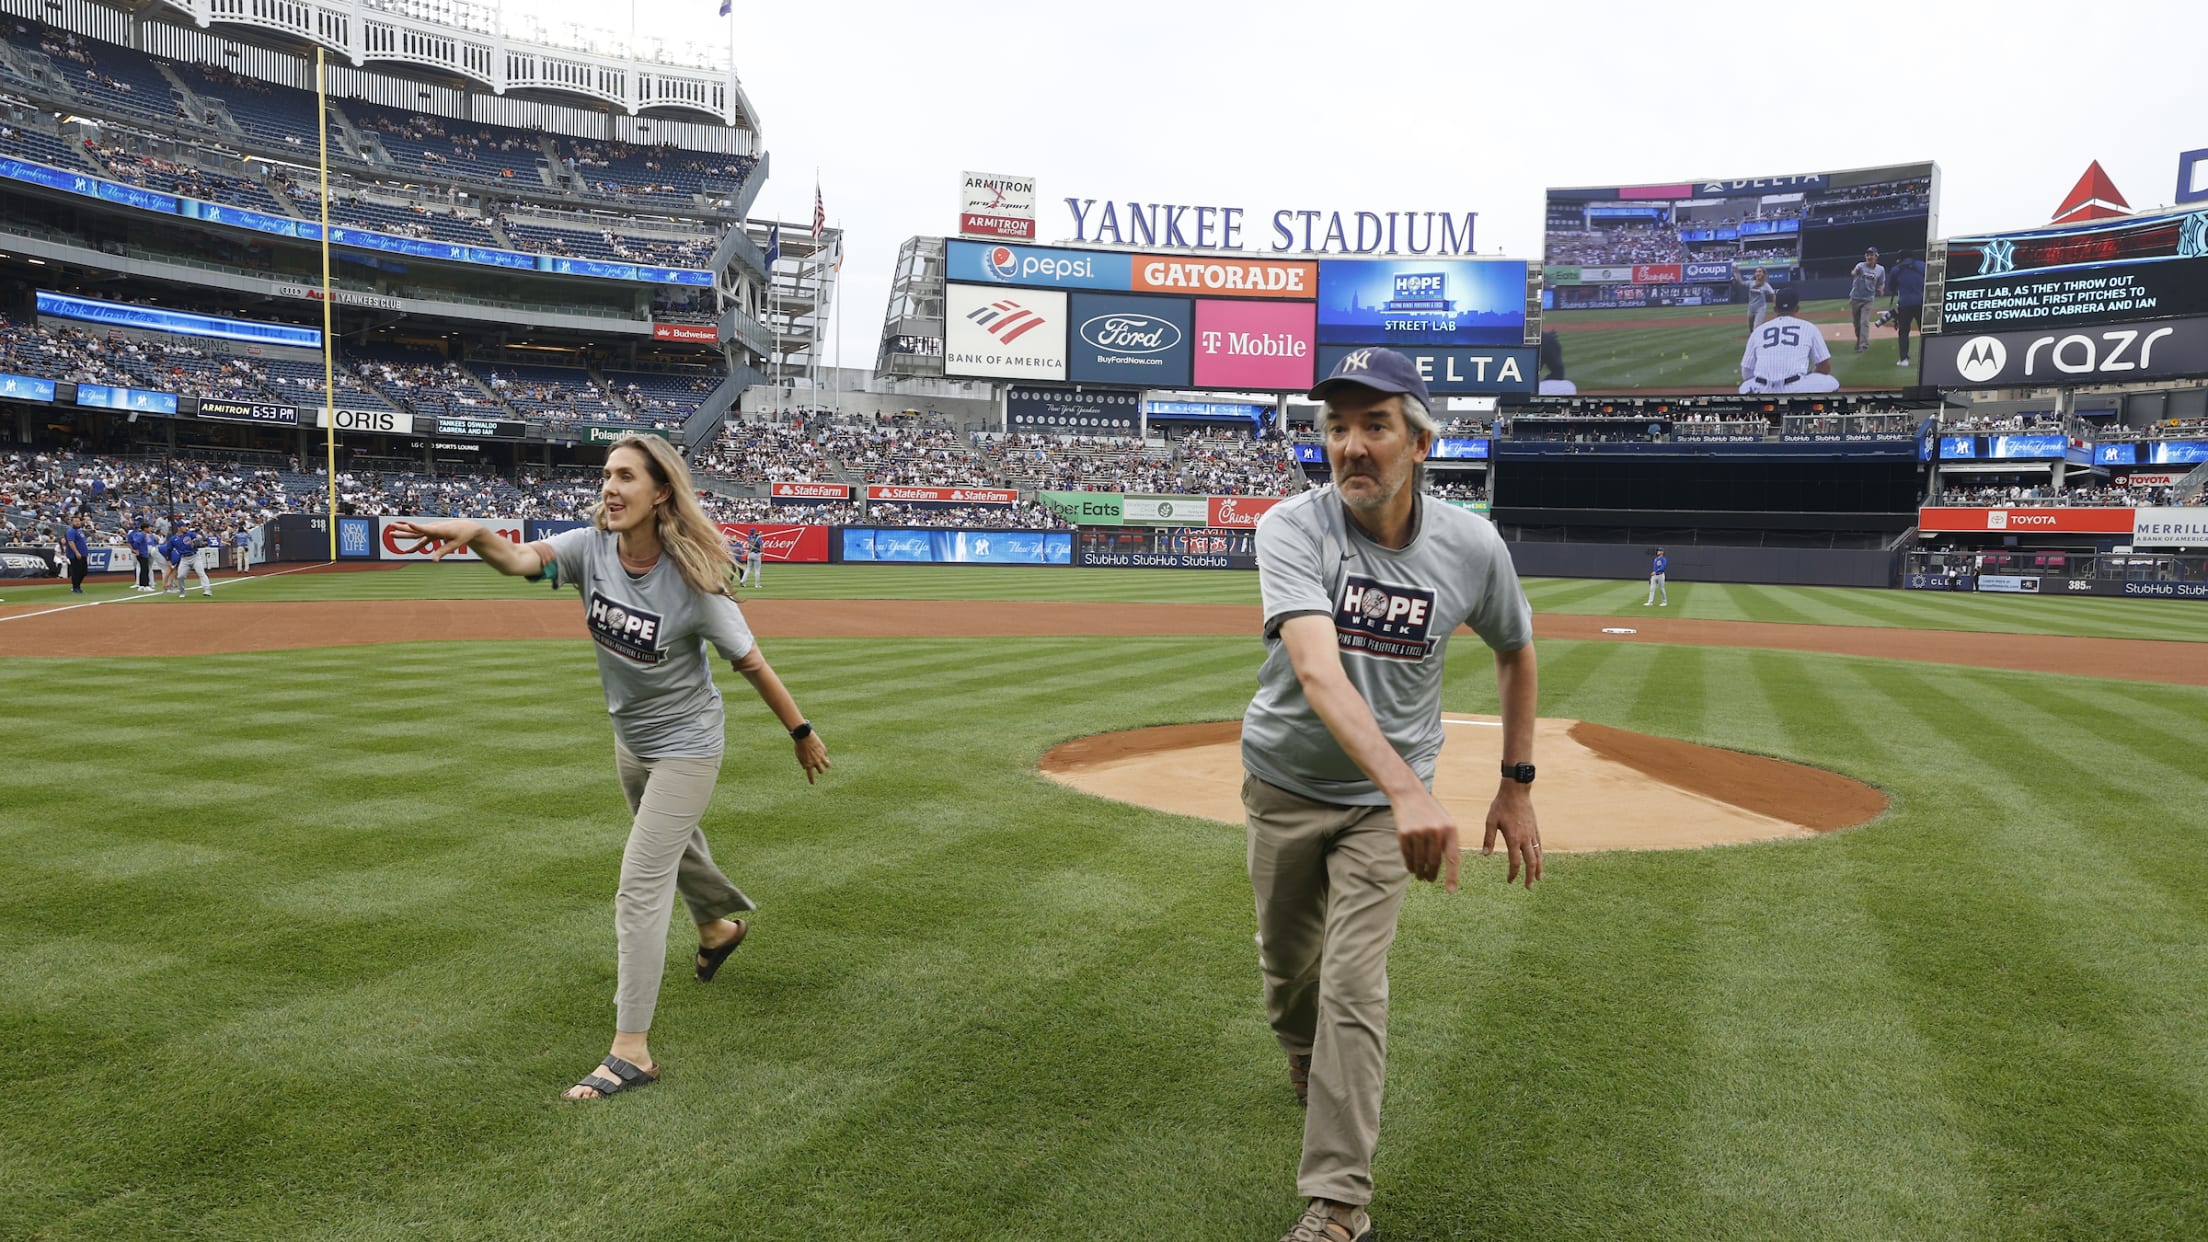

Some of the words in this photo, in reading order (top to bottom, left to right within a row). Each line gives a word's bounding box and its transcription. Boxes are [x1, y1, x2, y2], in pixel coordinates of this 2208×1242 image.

[965, 178, 1032, 193] ARMITRON
[968, 217, 1029, 230] ARMITRON
[1063, 197, 1244, 250] YANKEE
[1271, 209, 1479, 255] STADIUM
[1023, 255, 1091, 281] pepsi
[1699, 265, 1726, 276] coupa
[1144, 263, 1304, 291] GATORADE
[1946, 289, 1985, 301] STREET
[1987, 286, 2012, 299] LAB,
[2014, 284, 2029, 296] AS
[2032, 282, 2061, 294] THEY
[2064, 278, 2108, 292] THROW
[2110, 275, 2134, 287] OUT
[341, 293, 378, 306] YANKEES
[381, 298, 401, 309] CLUB
[1945, 300, 1968, 312] OUR
[1970, 295, 2040, 310] CEREMONIAL
[2042, 292, 2076, 305] FIRST
[2077, 288, 2128, 303] PITCHES
[2130, 286, 2145, 298] TO
[1944, 311, 1993, 324] YANKEES
[1994, 307, 2049, 320] OSWALDO
[2051, 303, 2105, 316] CABRERA
[2107, 300, 2133, 311] AND
[2135, 298, 2156, 309] IAN
[1098, 317, 1163, 349] Ford
[1385, 320, 1429, 331] STREET
[1432, 320, 1457, 331] LAB
[673, 328, 716, 340] Budweiser
[1763, 326, 1800, 349] 95
[1228, 332, 1307, 358] Mobile
[2024, 327, 2174, 376] razr
[948, 353, 984, 365] BANK
[986, 355, 1002, 366] OF
[1004, 355, 1063, 369] AMERICA
[1097, 355, 1163, 367] BuyFordNow.com
[1416, 356, 1522, 383] ELTA
[202, 403, 250, 415] ARMITRON
[252, 405, 276, 418] 6:53
[279, 408, 294, 420] PM
[335, 410, 394, 430] ORIS
[439, 420, 466, 428] YANKEES
[467, 422, 498, 430] OSWALDO
[439, 426, 466, 434] CABRERA
[590, 427, 625, 441] Poland
[2130, 476, 2171, 484] TOYOTA
[1048, 501, 1079, 515] ber
[1083, 502, 1120, 516] Eats
[310, 518, 326, 529] 318
[344, 523, 365, 533] NEW
[2011, 516, 2057, 525] TOYOTA
[2137, 524, 2208, 534] MERRILL
[342, 532, 367, 542] YORK
[345, 541, 365, 551] LIFE
[1085, 553, 1129, 565] StubHub
[1132, 555, 1178, 567] StubHub
[1181, 556, 1228, 567] StubHub
[1930, 578, 1962, 586] CLER
[2068, 580, 2086, 590] 385
[2126, 583, 2173, 594] StubHub
[1343, 585, 1428, 625] HOPE
[592, 599, 656, 641] HOPE
[1352, 615, 1411, 634] WEEK
[597, 622, 643, 646] WEEK
